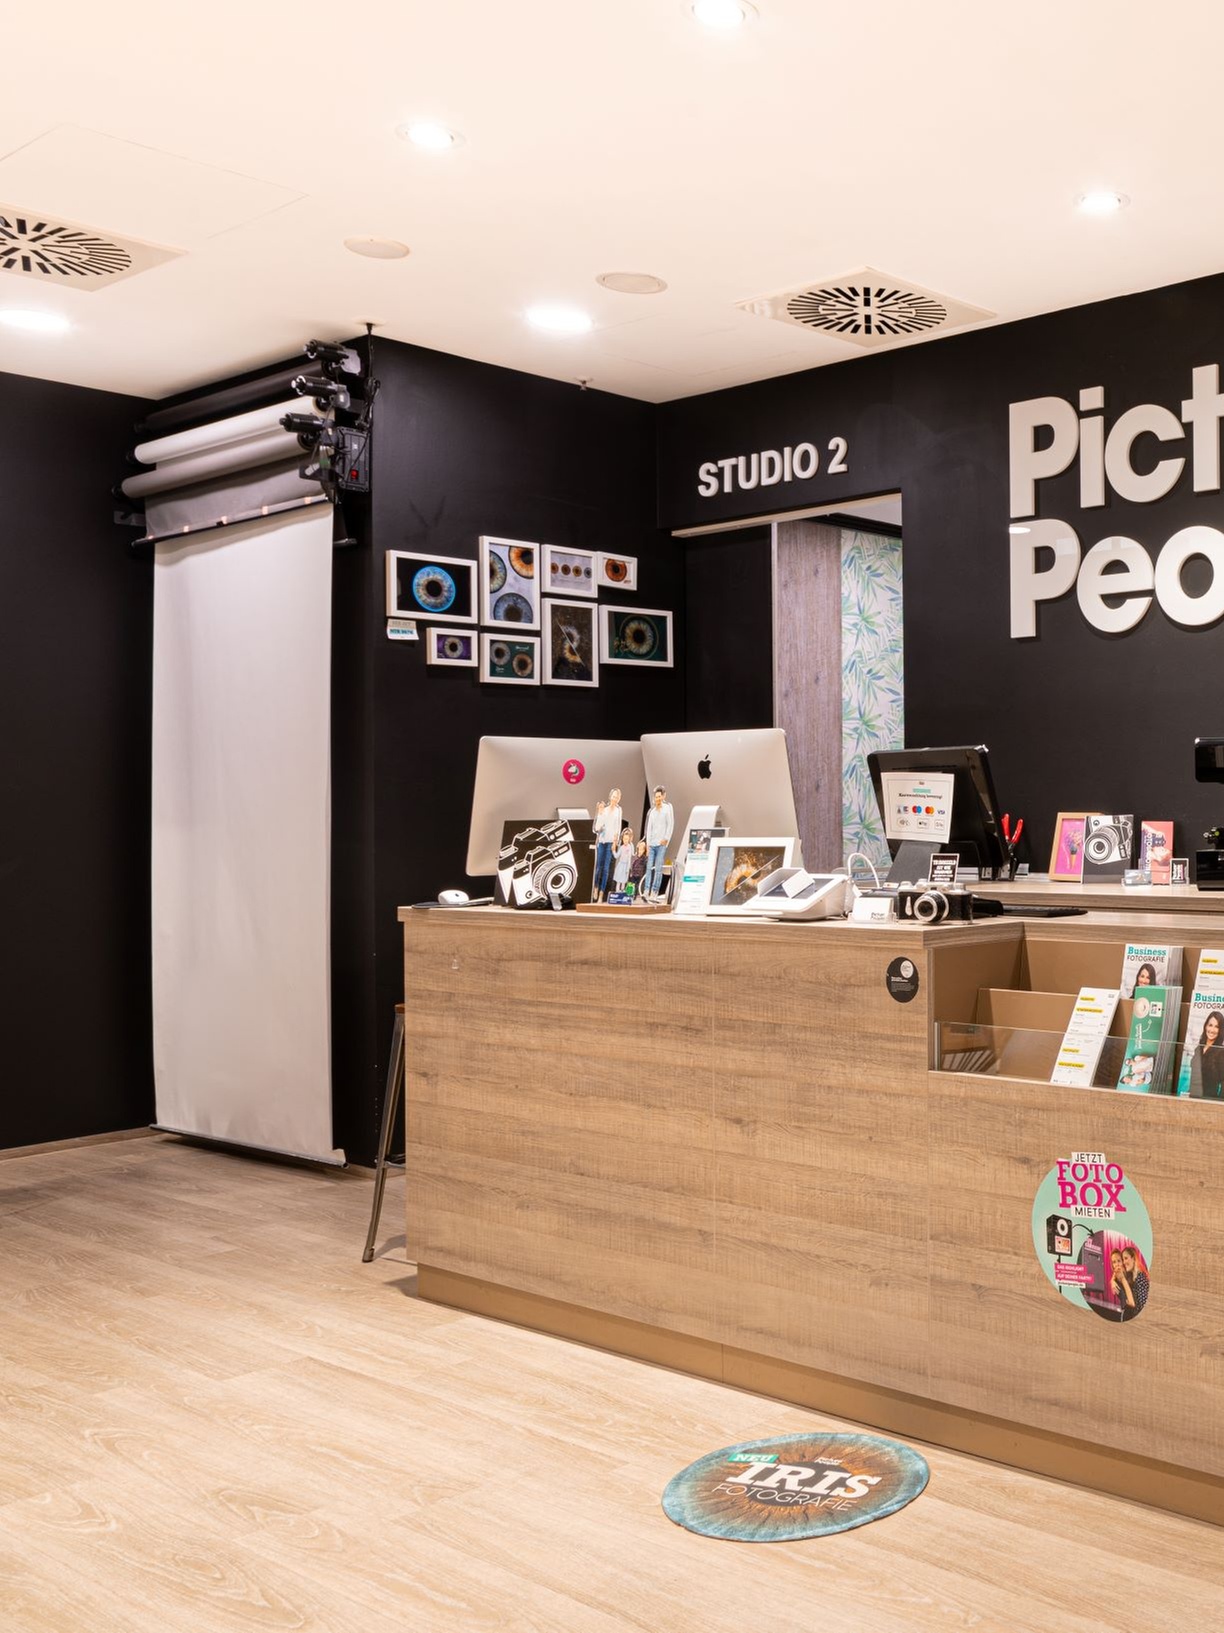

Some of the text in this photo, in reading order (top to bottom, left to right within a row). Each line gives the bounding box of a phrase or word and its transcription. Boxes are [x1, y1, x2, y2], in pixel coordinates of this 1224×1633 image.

[697, 436, 849, 498] STUDIO 2
[1127, 955, 1165, 963] FOTOGRAFIE
[1128, 946, 1167, 956] Business
[1074, 1153, 1103, 1163] JETZT
[1056, 1160, 1124, 1184] FOTO
[1057, 1181, 1127, 1213] BOX
[1074, 1206, 1111, 1218] MIETEN
[734, 1453, 774, 1462] NEU
[725, 1461, 882, 1499] IRIS
[711, 1482, 858, 1511] FOTOGRAFIE
